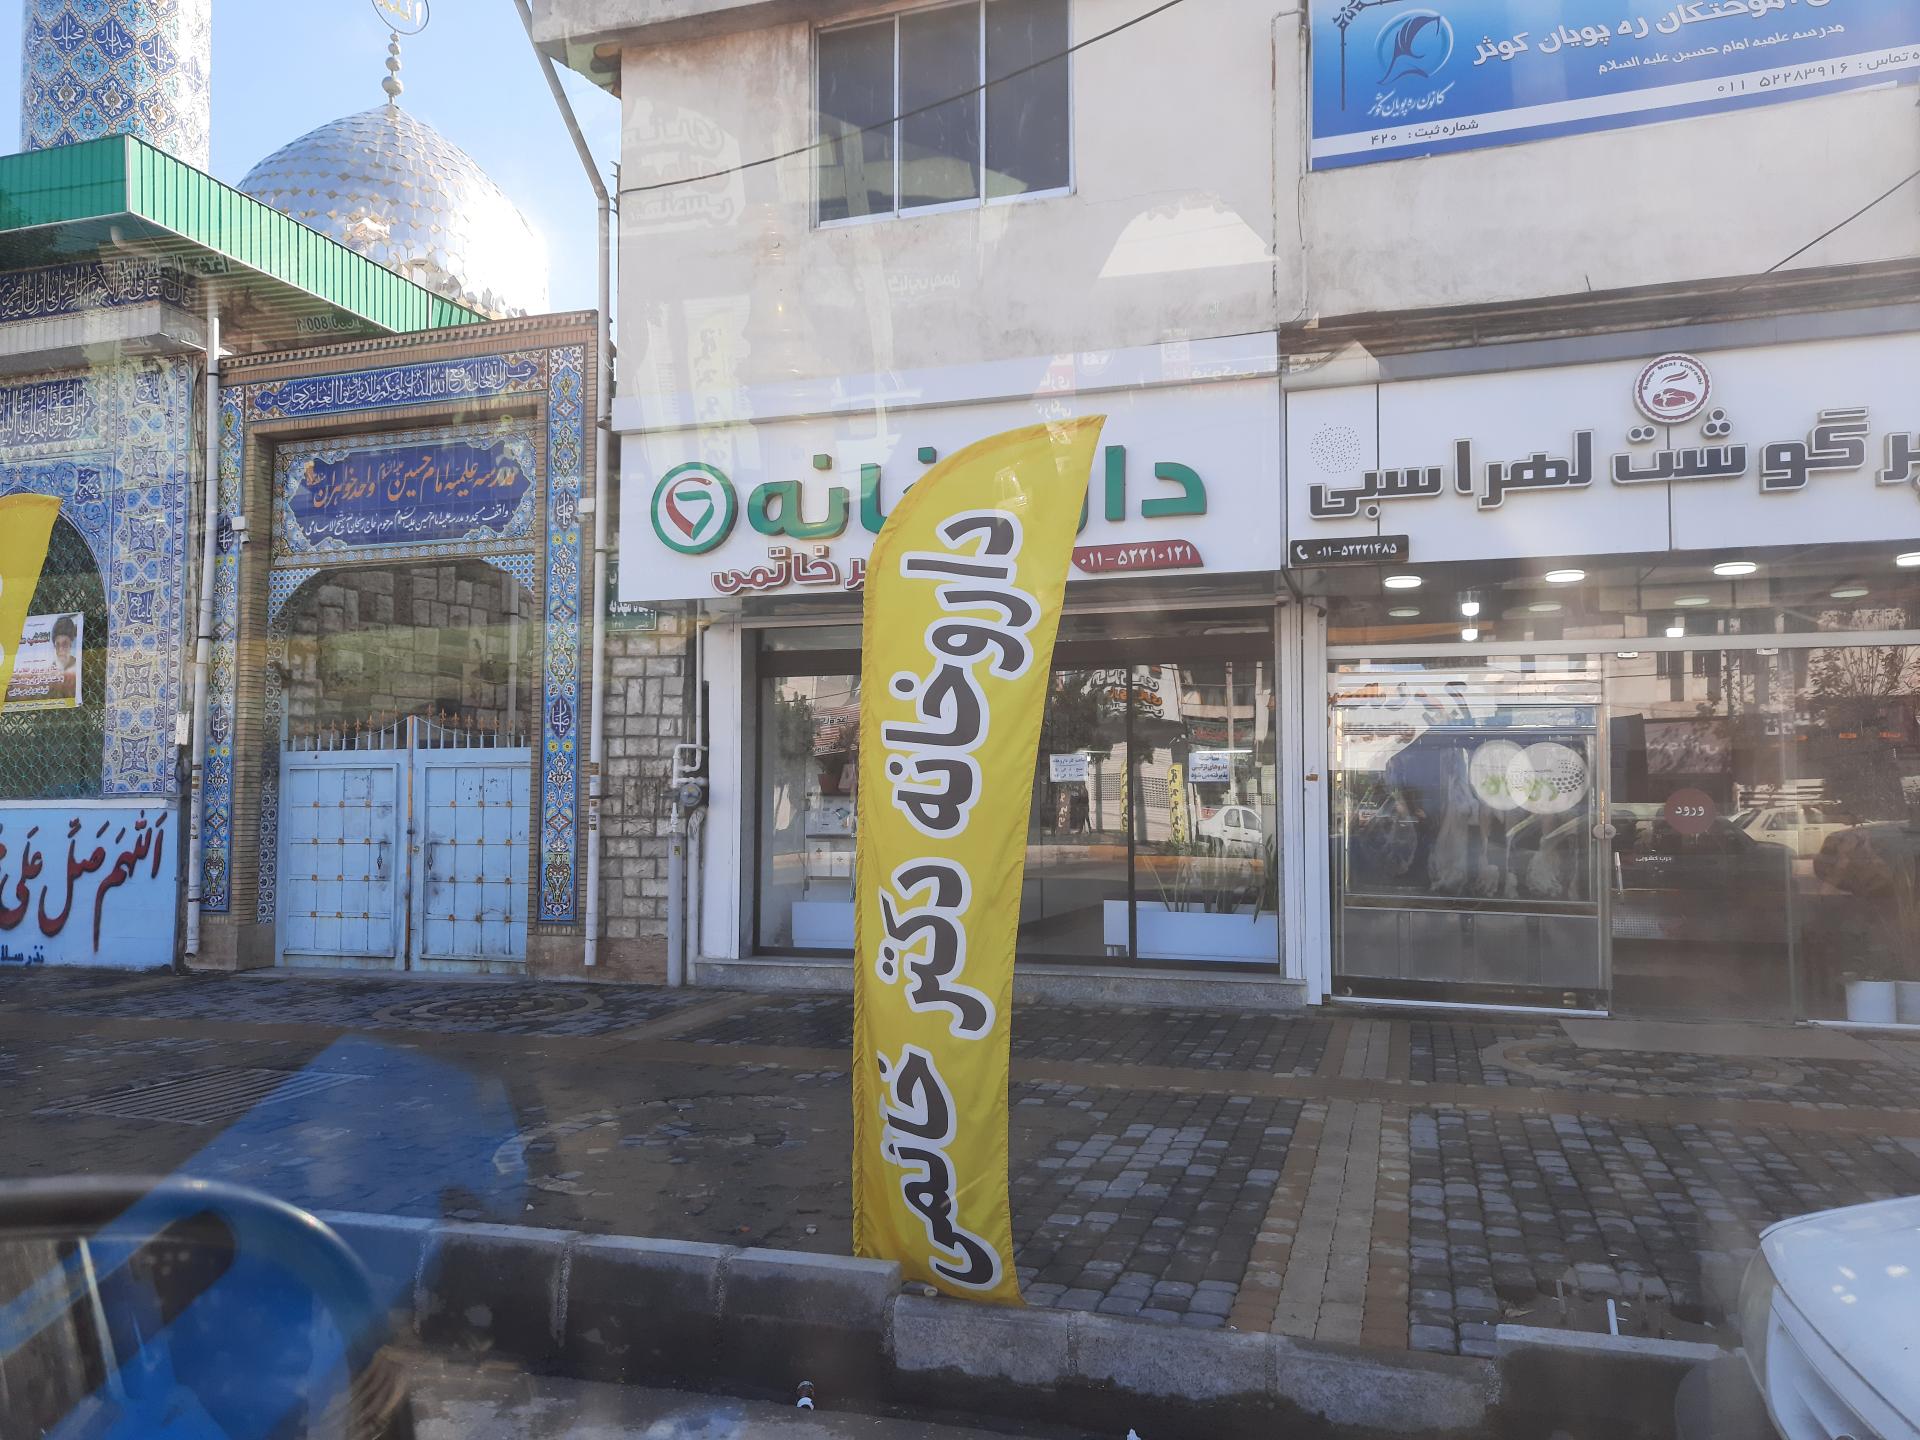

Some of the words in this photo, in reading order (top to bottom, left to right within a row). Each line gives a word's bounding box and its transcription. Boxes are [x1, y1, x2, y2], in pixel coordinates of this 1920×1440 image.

[1538, 22, 1611, 54] پویان
[1752, 31, 1789, 49] علمیه
[1791, 21, 1846, 41] مدرسه
[1473, 31, 1529, 65] کوثر
[1671, 45, 1719, 63] حسین
[1721, 38, 1750, 55] امام
[1598, 56, 1640, 75] السلام
[1643, 53, 1668, 67] علیه
[1442, 119, 1479, 136] شماره
[1657, 361, 1676, 370] Meat
[1611, 405, 1870, 494] گوشت
[1307, 429, 1594, 519] لهراسبی
[711, 545, 841, 595] خاتمی
[884, 512, 1036, 834] داروخانه
[1674, 803, 1705, 817] ورود
[878, 860, 992, 1037] دکتر
[877, 1047, 998, 1289] خاتمی
